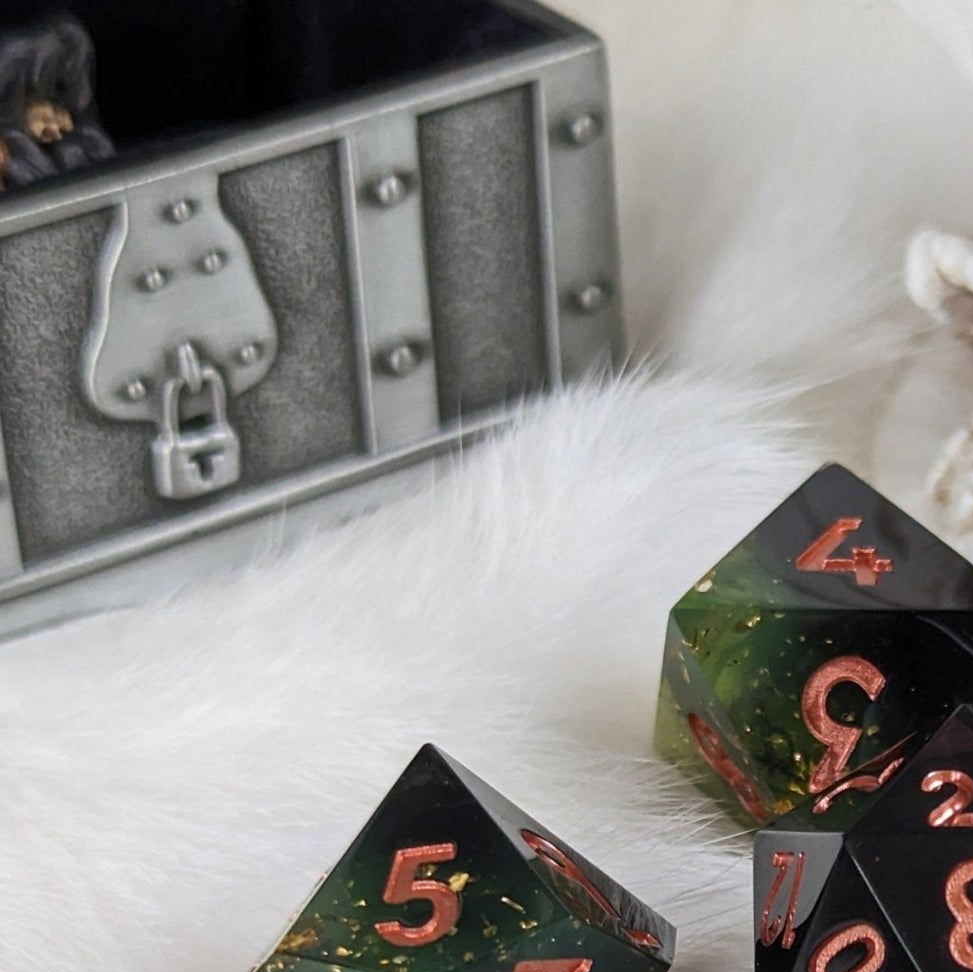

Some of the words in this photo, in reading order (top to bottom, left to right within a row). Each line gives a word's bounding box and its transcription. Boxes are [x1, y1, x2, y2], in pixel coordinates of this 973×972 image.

[796, 517, 894, 586] 4
[374, 843, 462, 947] 5
[760, 852, 805, 950] 12
